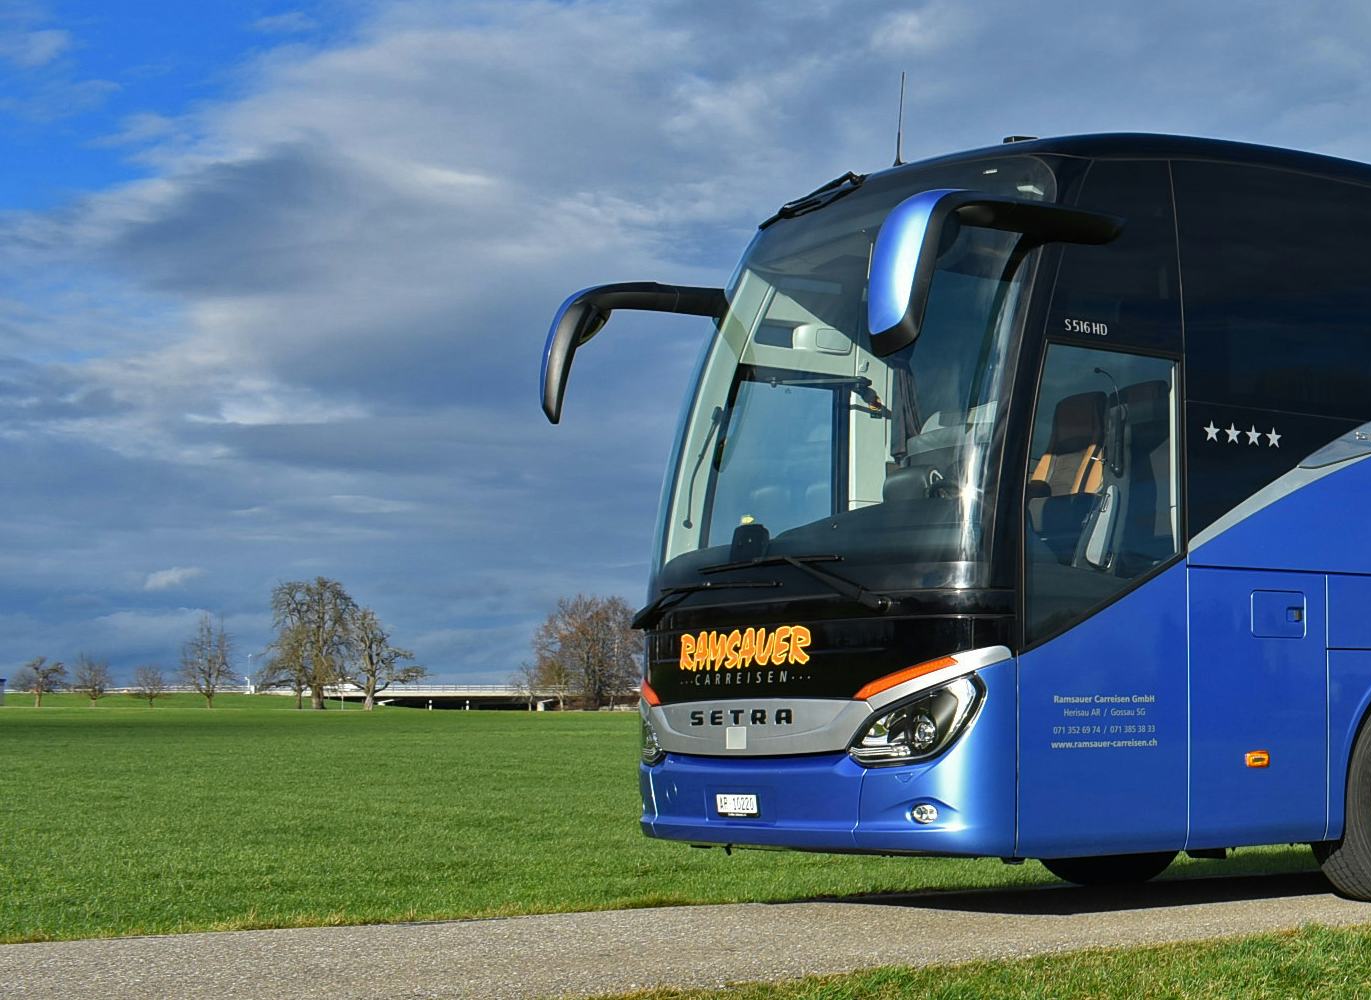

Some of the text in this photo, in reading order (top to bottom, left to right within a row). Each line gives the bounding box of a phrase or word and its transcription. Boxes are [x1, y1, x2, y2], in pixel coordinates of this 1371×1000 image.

[679, 625, 811, 672] RAMSAUER
[1053, 694, 1155, 704] Ramsauer Carreisen GmbH
[689, 708, 793, 727] SETRA
[1063, 708, 1089, 717] Herisau
[1090, 708, 1101, 717] AR
[1110, 708, 1135, 716] Gossau
[1136, 708, 1146, 716] SG
[1050, 738, 1158, 749] www.ramsauer-carreisen.ch
